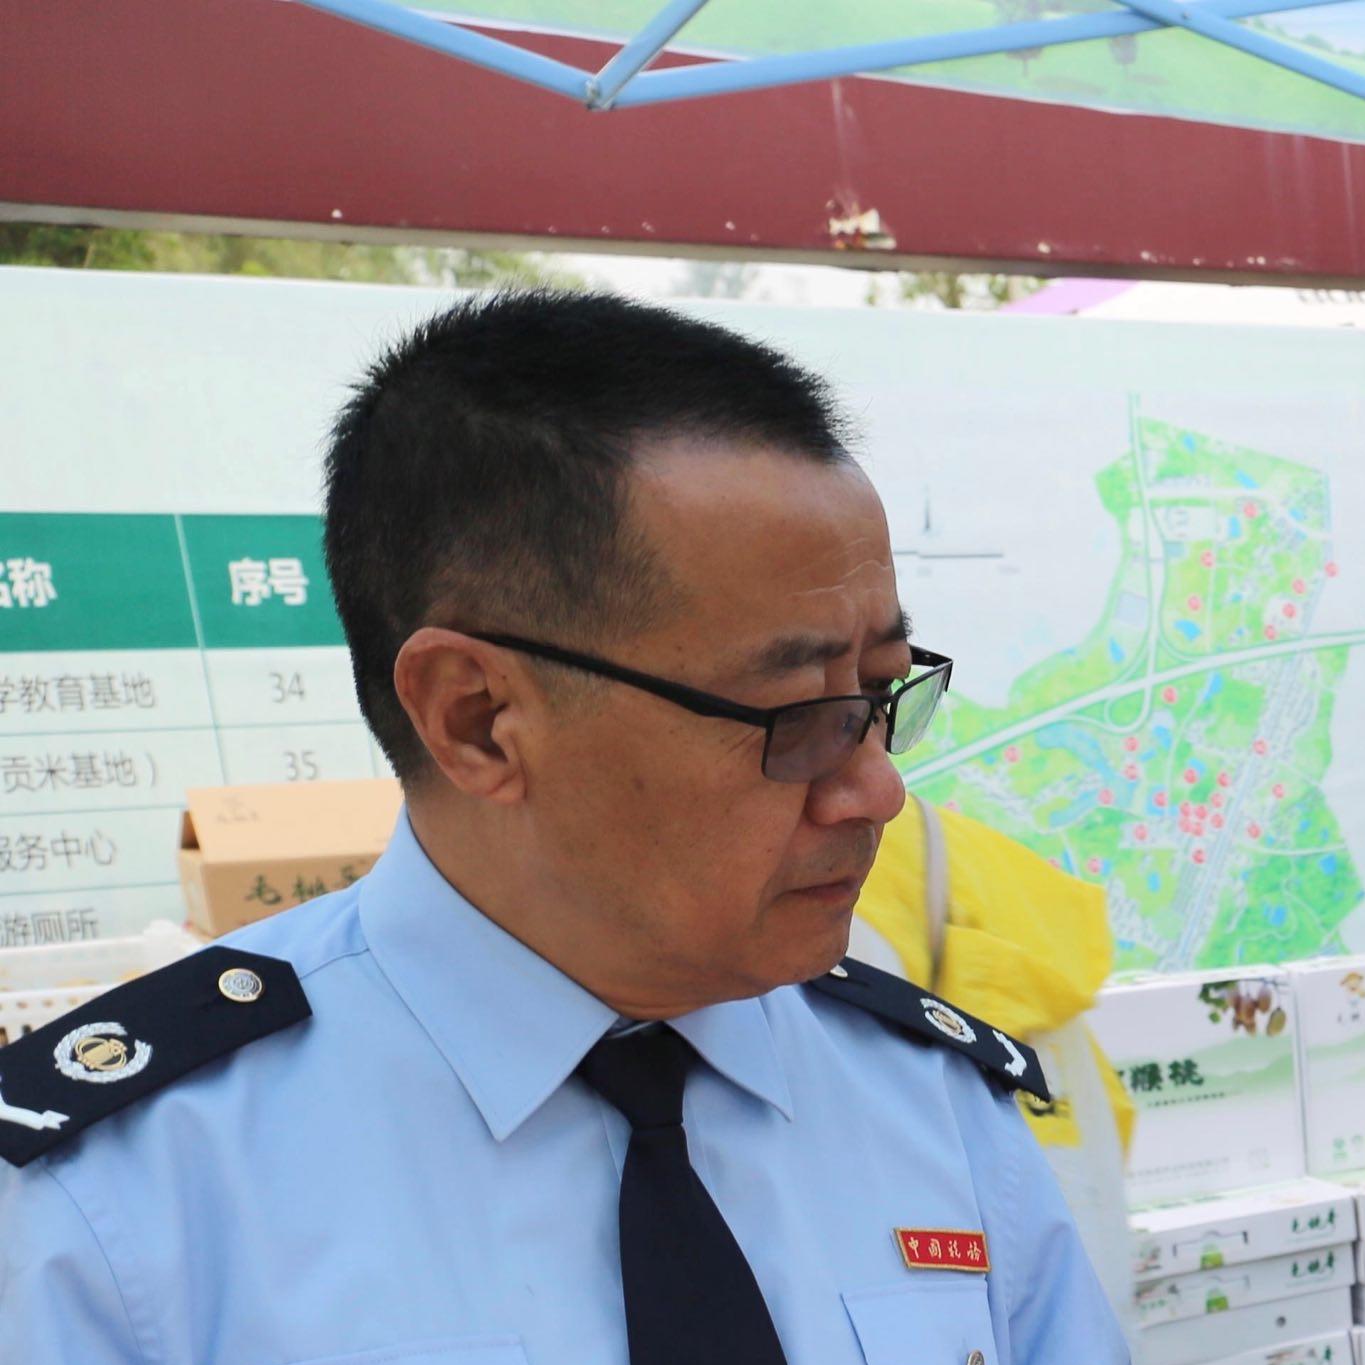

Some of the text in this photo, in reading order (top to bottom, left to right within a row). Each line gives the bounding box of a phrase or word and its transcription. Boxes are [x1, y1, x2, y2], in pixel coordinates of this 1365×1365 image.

[228, 557, 309, 607] 序号
[268, 671, 305, 703] 34
[281, 750, 320, 781] 35
[1116, 1058, 1204, 1093] 猴桃
